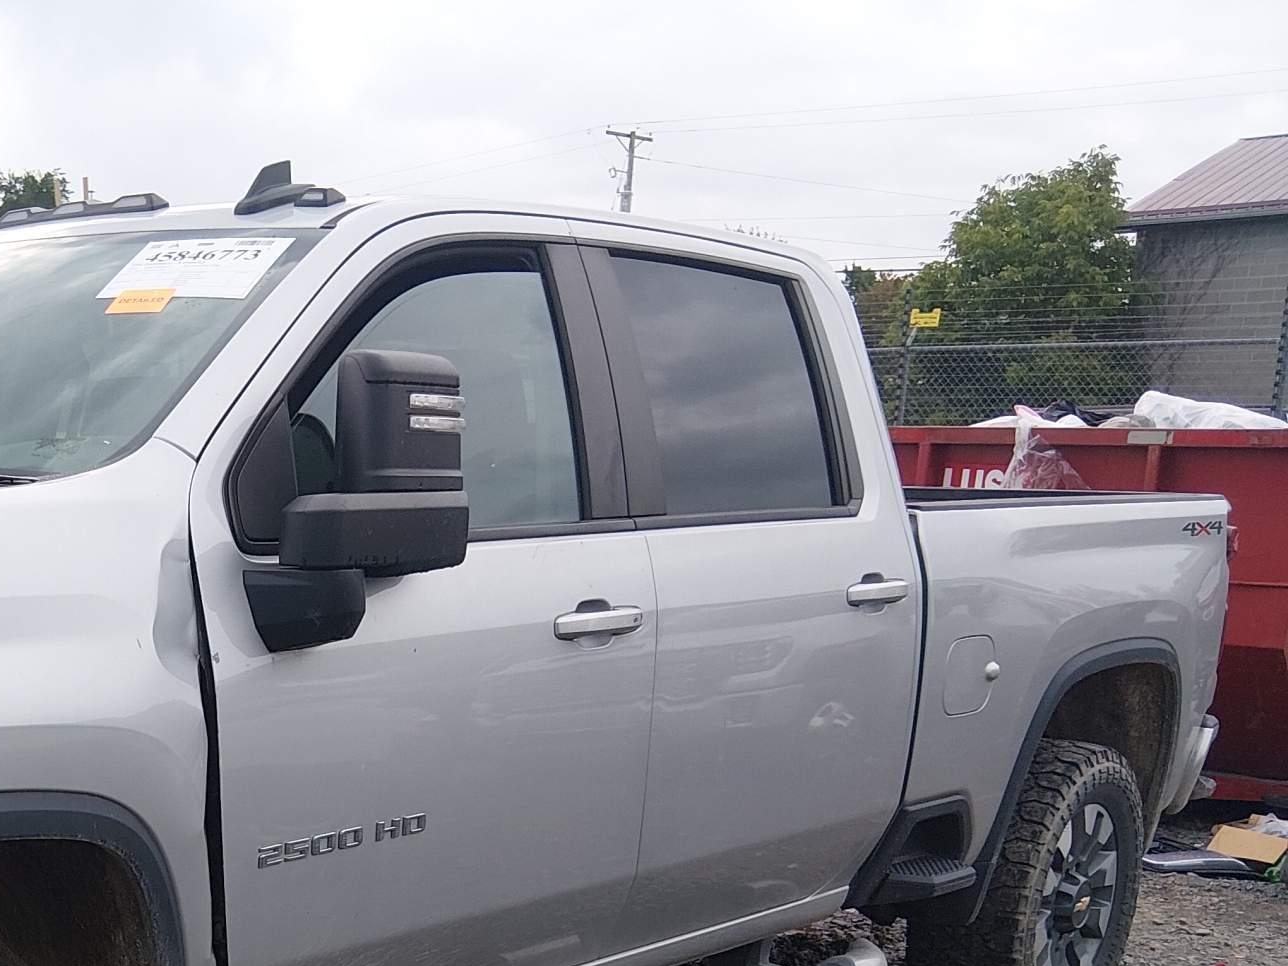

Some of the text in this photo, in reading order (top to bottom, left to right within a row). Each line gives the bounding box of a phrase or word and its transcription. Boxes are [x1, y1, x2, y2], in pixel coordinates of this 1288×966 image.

[146, 250, 262, 263] 45846773
[257, 812, 427, 870] 2500 HD
